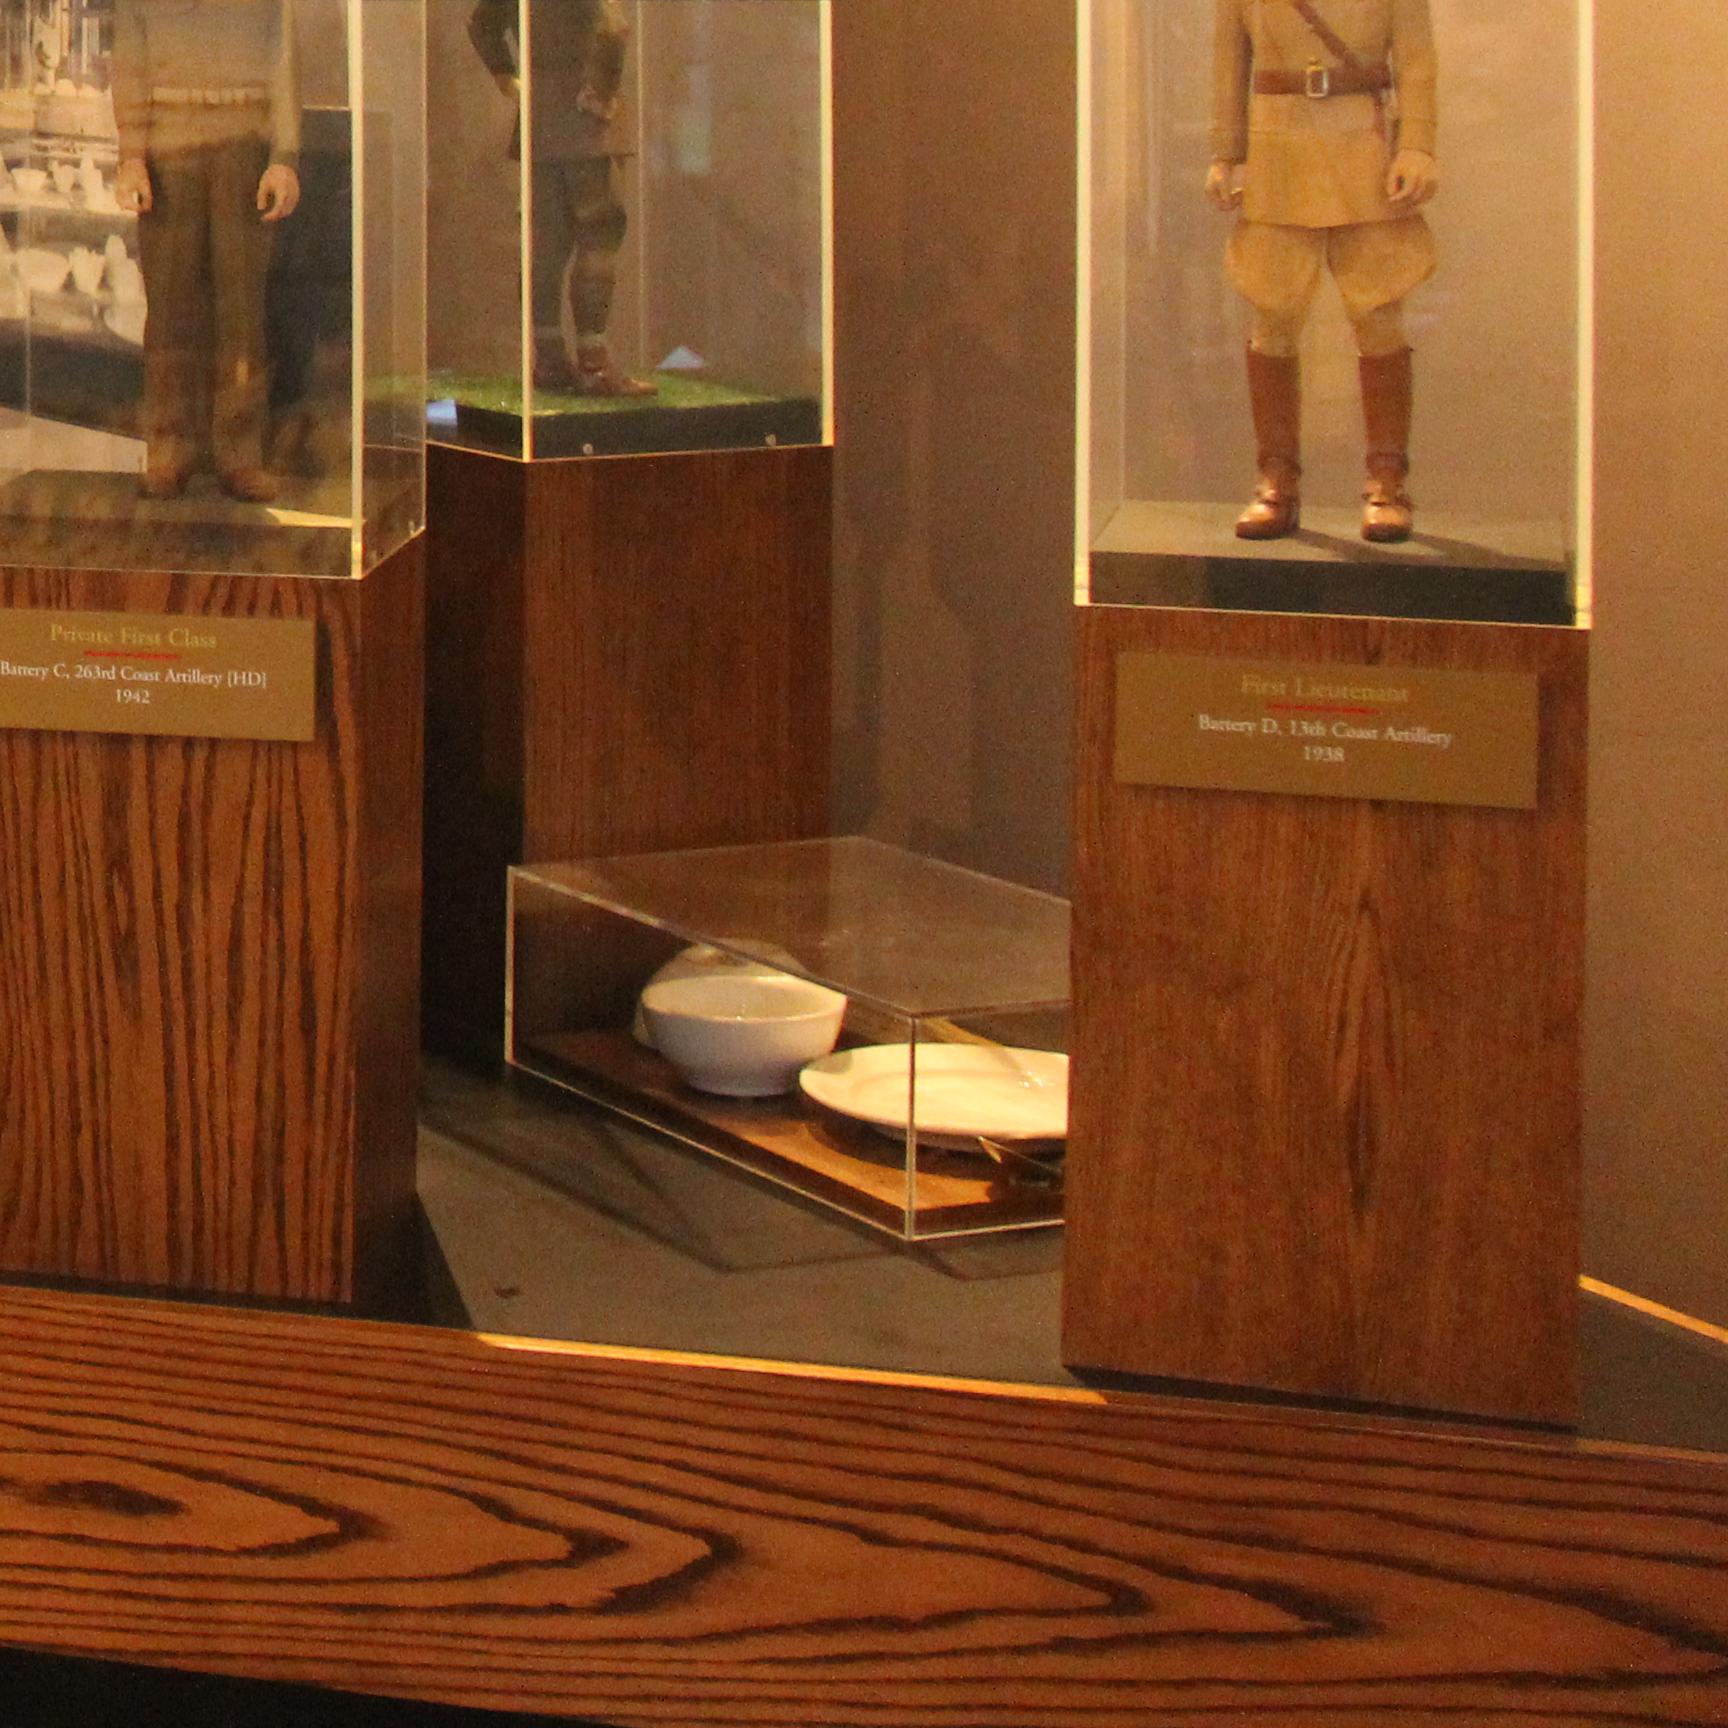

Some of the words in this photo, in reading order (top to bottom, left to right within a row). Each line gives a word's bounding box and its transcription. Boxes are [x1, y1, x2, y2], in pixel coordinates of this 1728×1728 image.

[50, 623, 113, 643] Private
[120, 625, 161, 646] First
[168, 627, 217, 649] Class
[0, 660, 49, 680] Battery
[52, 662, 71, 679] C,
[74, 664, 116, 680] 263rd
[120, 665, 160, 681] Coast
[164, 668, 223, 688] Artillery
[115, 688, 151, 704] 1942
[1294, 677, 1409, 703] Lieutenant
[1199, 714, 1256, 737] Battery
[1261, 717, 1282, 736] D,
[1289, 719, 1326, 738] 13th
[1331, 721, 1378, 740] Coast
[1384, 726, 1452, 749] Artillery
[1303, 745, 1345, 763] 1938
